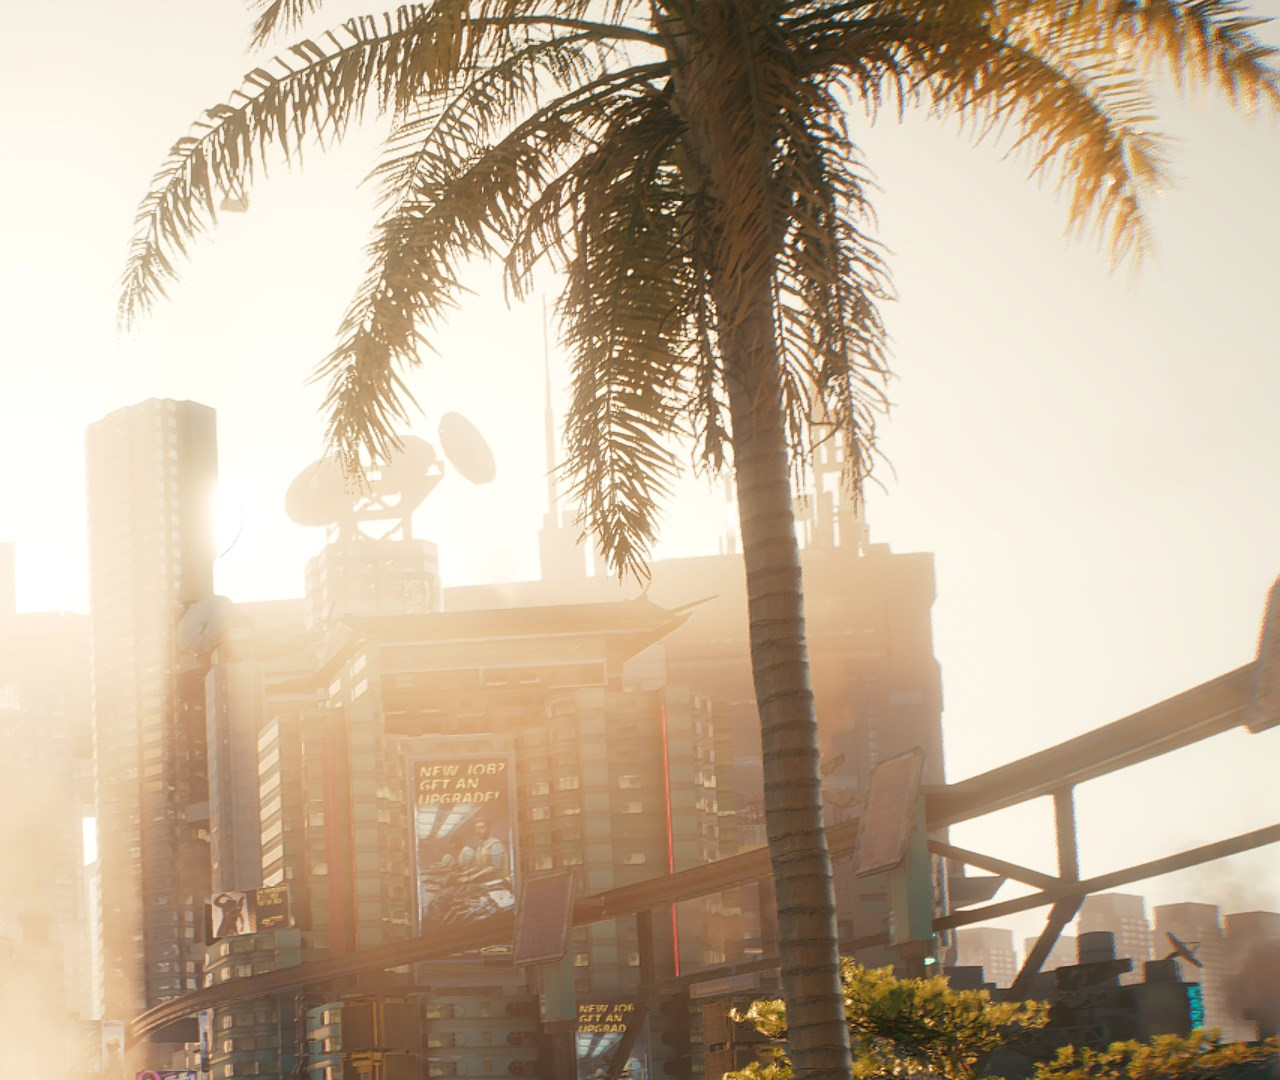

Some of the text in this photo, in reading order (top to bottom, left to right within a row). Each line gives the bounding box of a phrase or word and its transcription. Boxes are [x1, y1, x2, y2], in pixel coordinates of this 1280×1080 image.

[456, 777, 480, 789] AN
[606, 1013, 623, 1022] AN
[578, 1024, 627, 1033] UPGRAD
